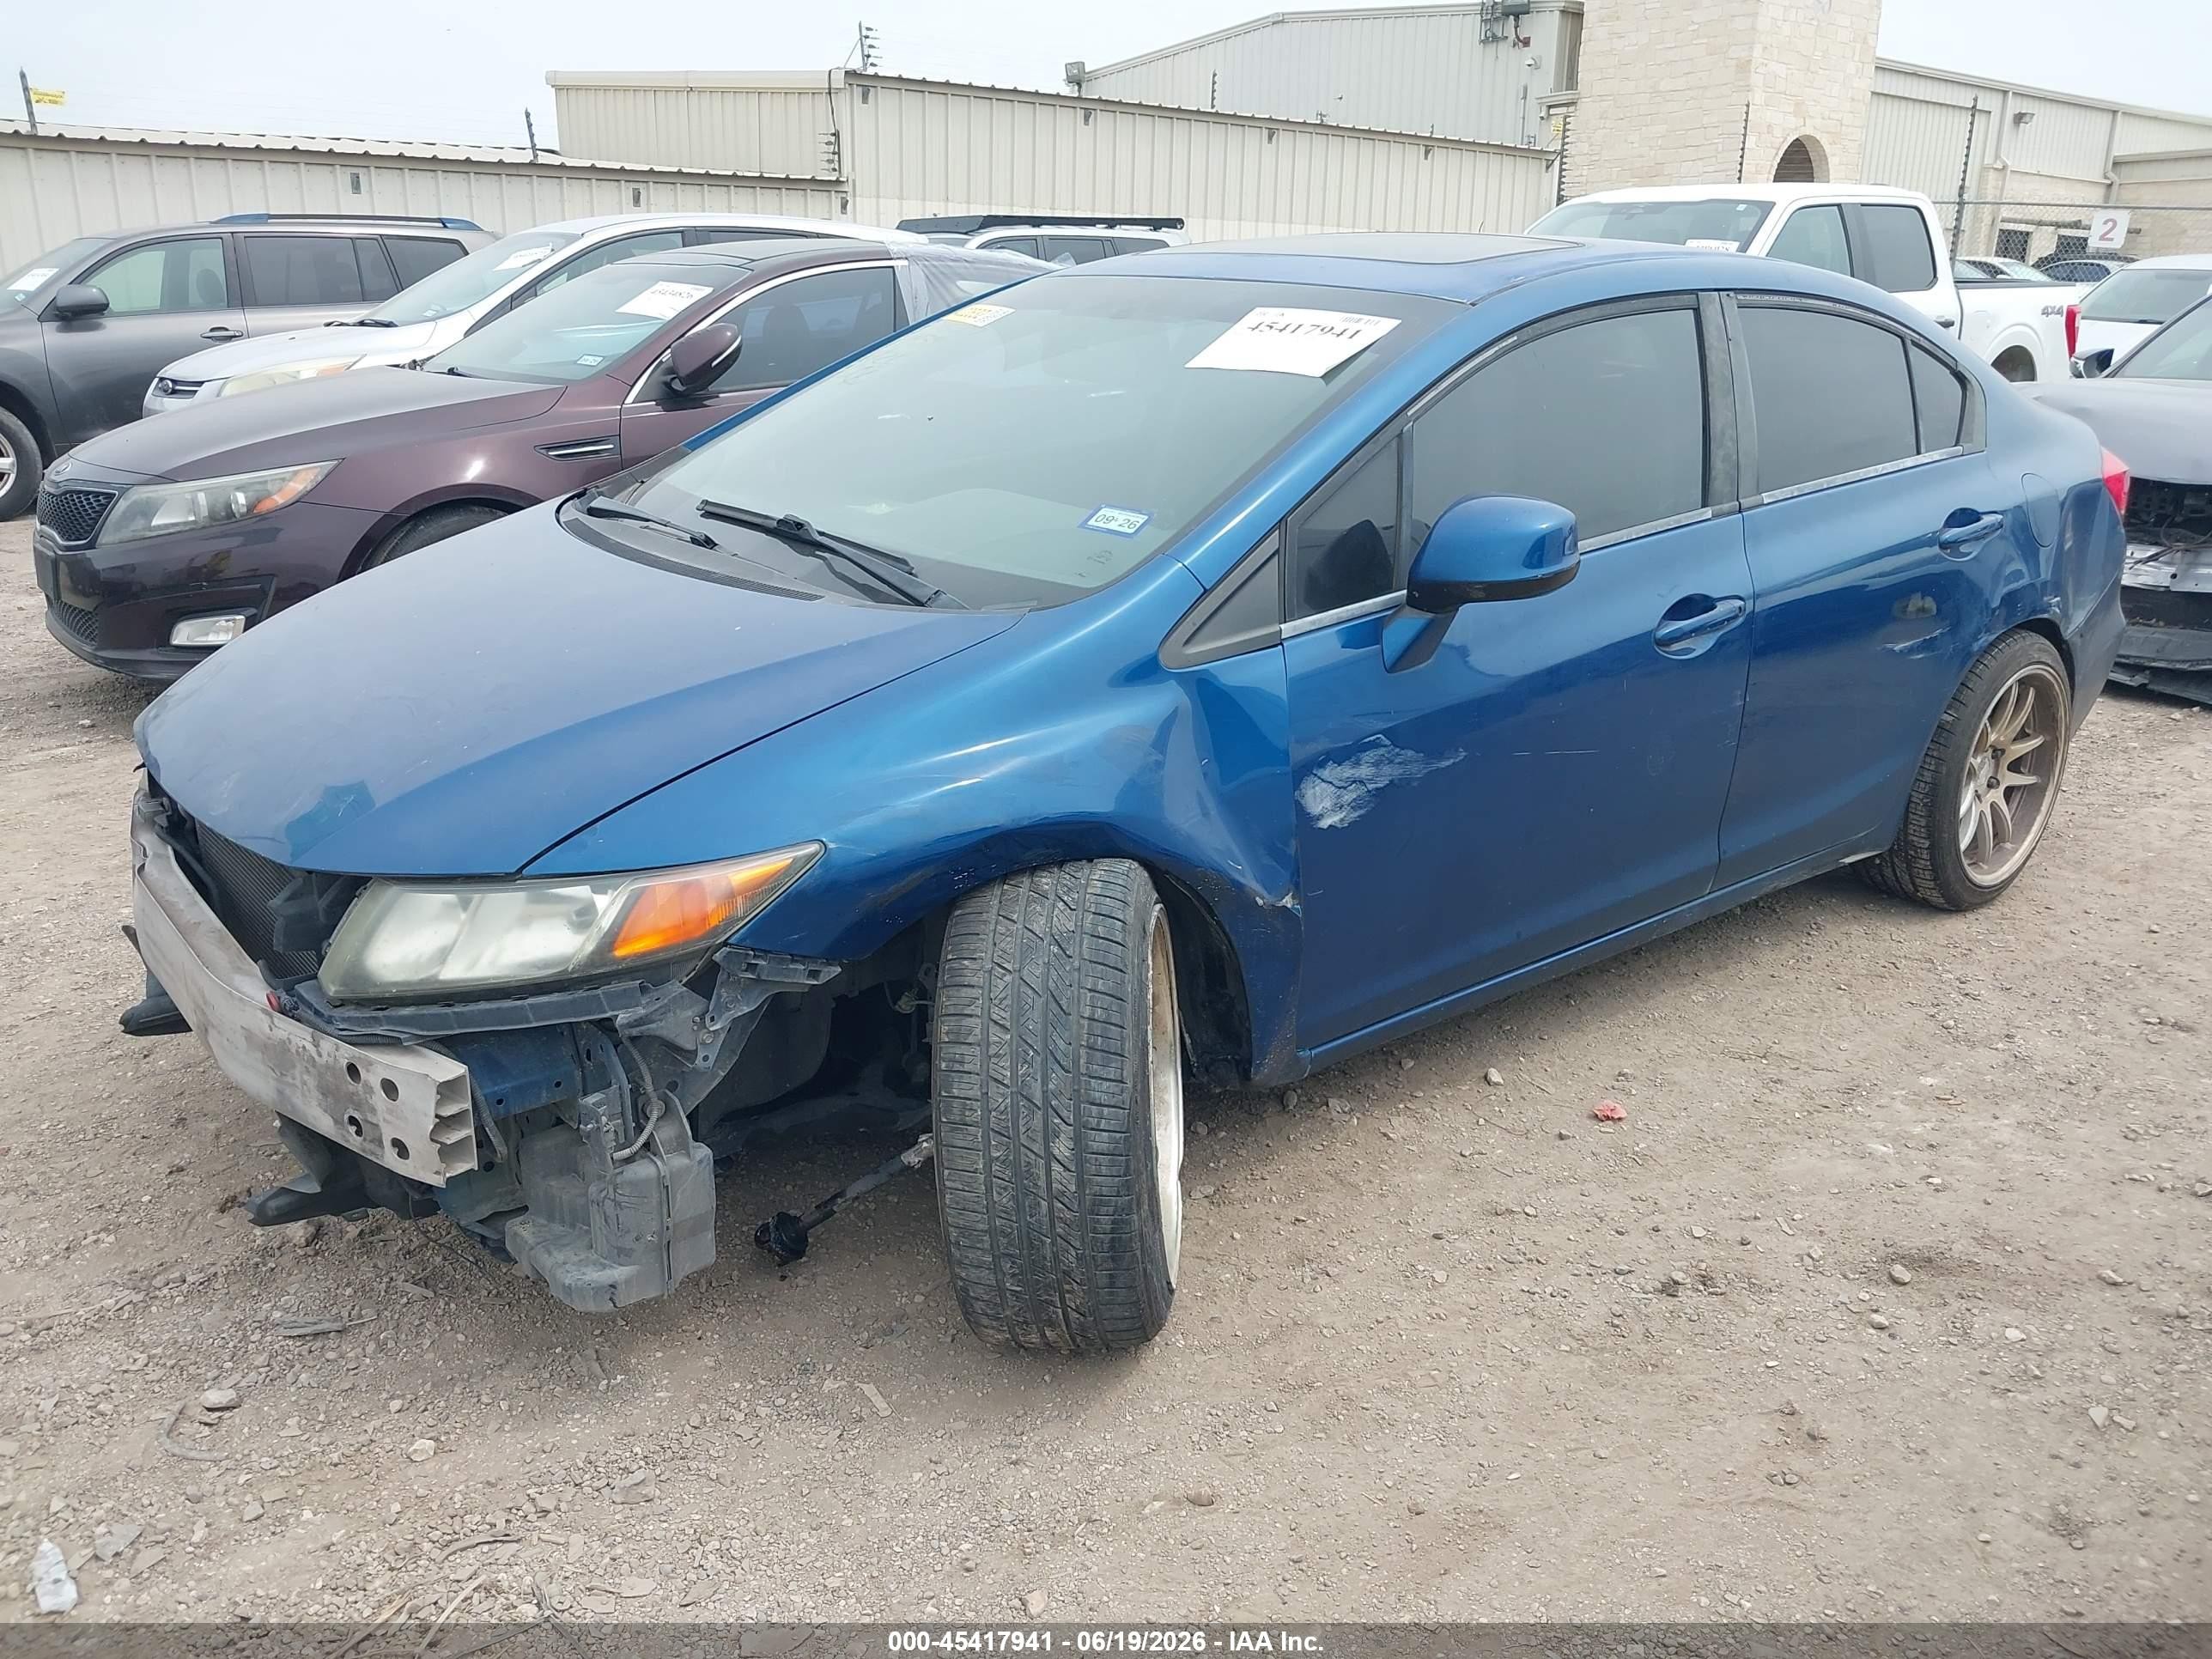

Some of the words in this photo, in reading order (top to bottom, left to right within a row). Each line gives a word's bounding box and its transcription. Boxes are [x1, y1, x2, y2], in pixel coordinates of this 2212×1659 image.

[2099, 218, 2118, 241] 2
[1247, 320, 1363, 339] 45417941
[1095, 514, 1115, 525] 09
[1118, 518, 1140, 529] 26
